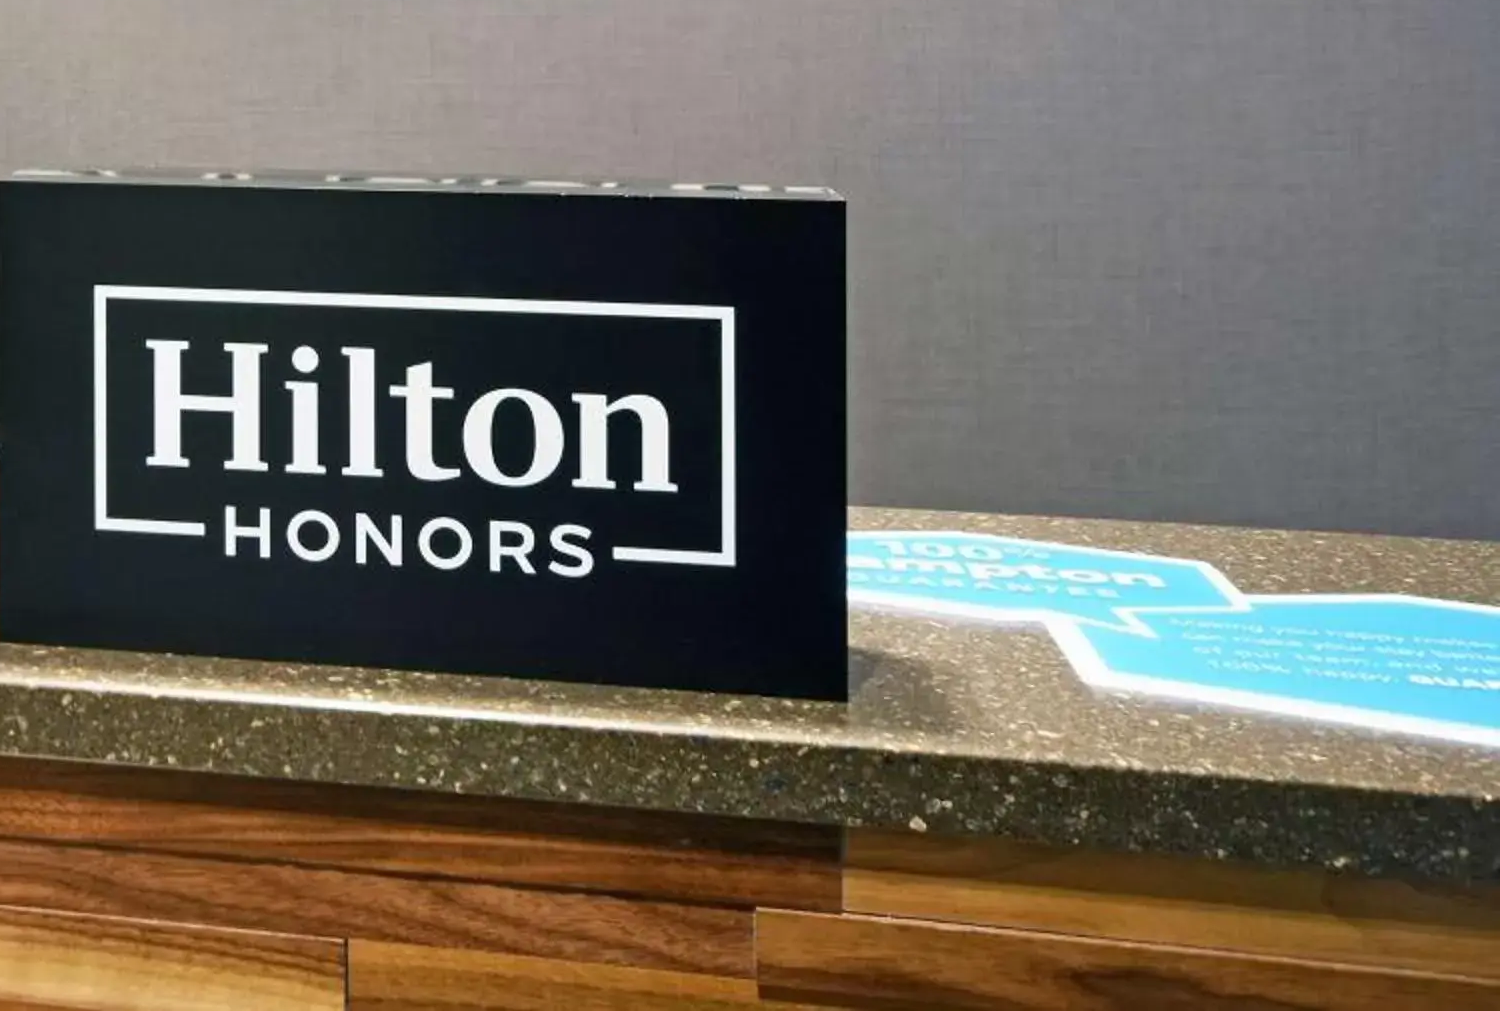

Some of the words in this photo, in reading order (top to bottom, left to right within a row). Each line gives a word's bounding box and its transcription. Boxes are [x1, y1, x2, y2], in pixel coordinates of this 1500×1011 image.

[144, 338, 680, 494] Hilton
[223, 504, 596, 579] HONORS
[873, 539, 1050, 561] 100%
[847, 553, 1168, 588] ampton
